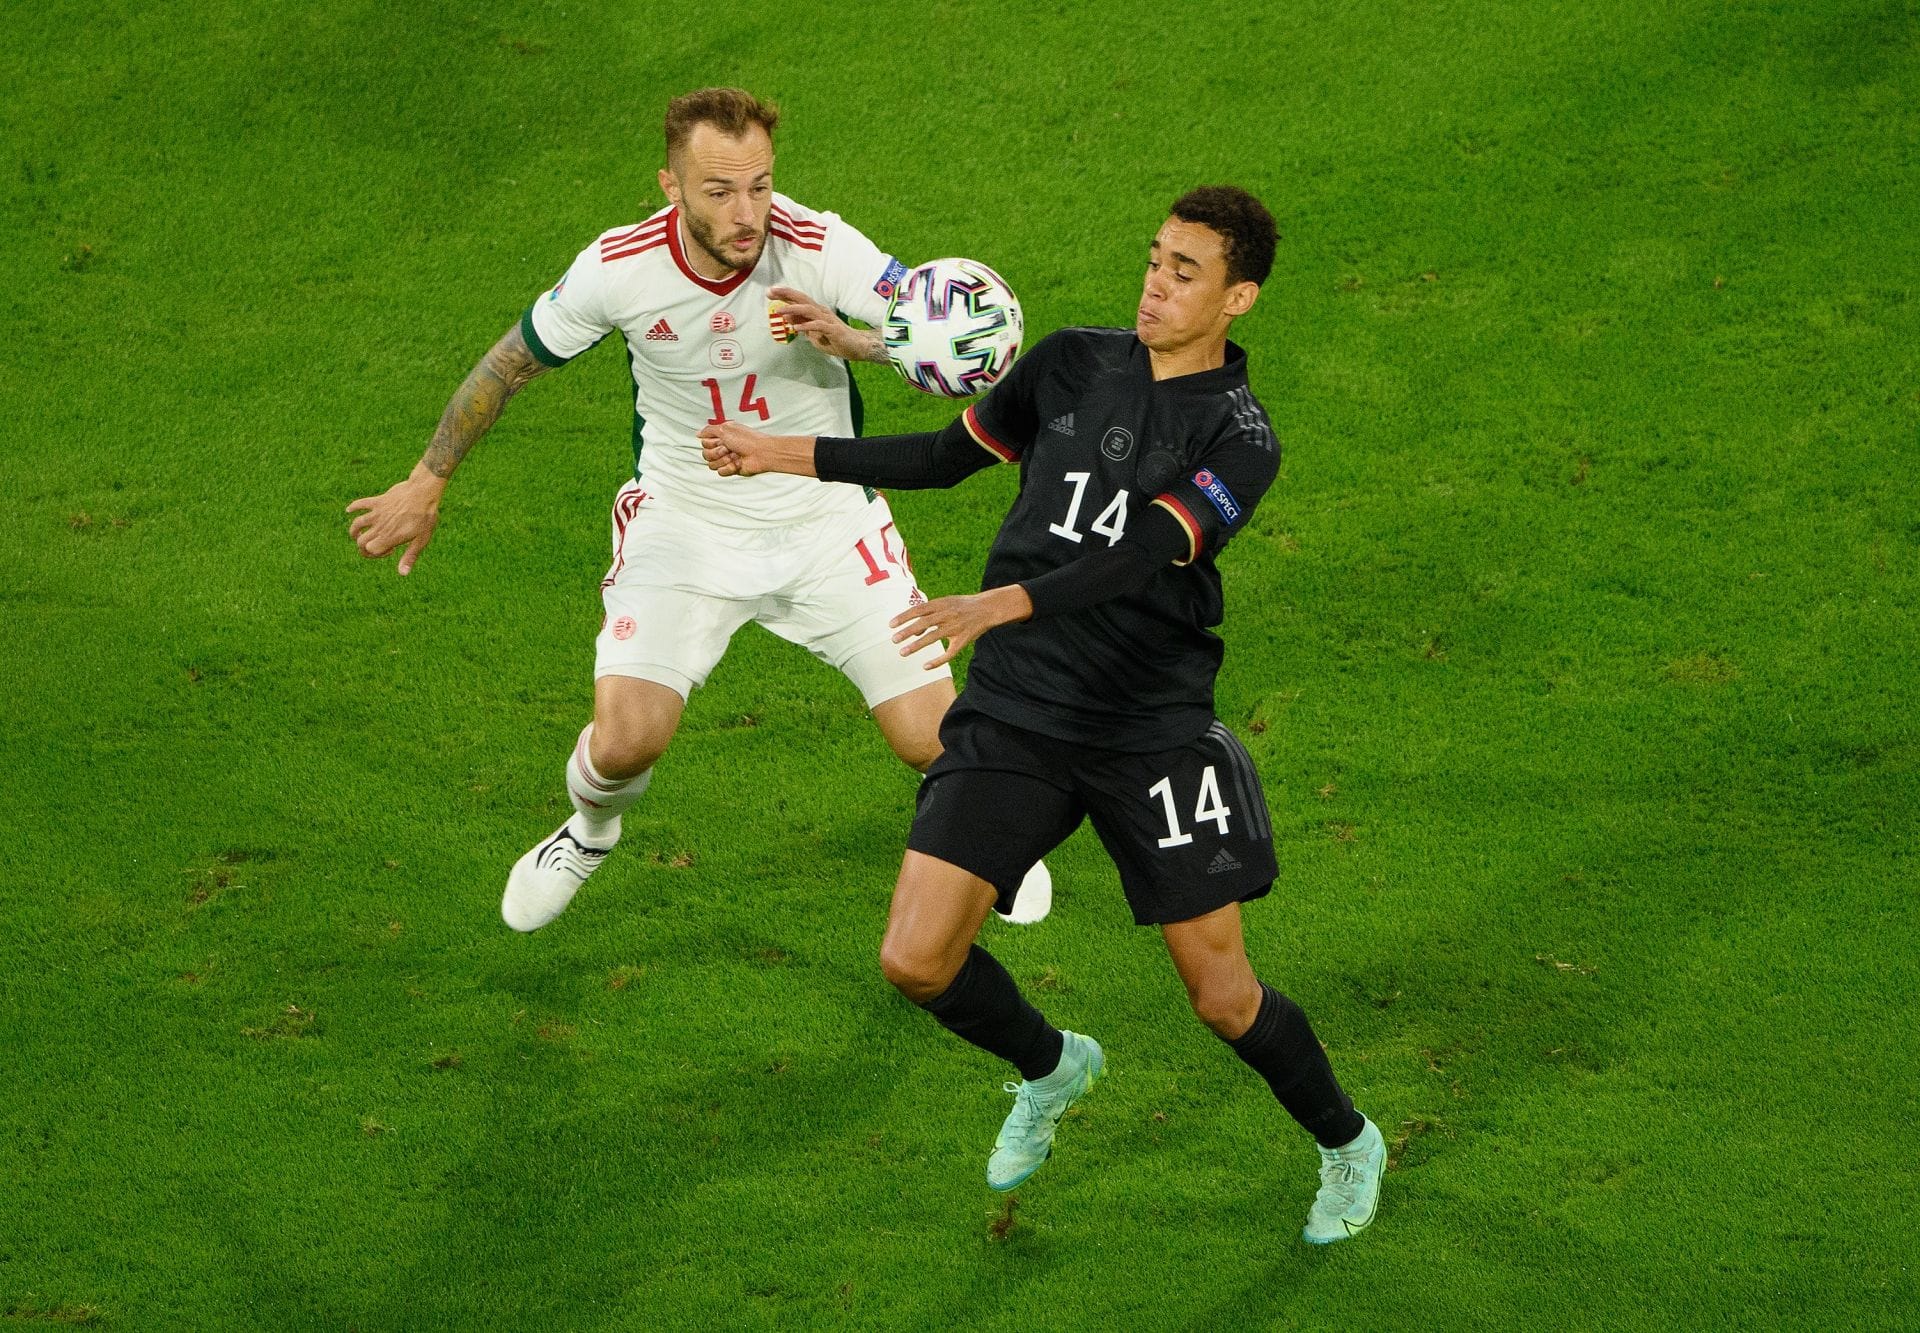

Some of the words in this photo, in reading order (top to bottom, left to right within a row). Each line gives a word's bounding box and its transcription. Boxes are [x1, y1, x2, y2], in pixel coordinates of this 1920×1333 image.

[645, 333, 679, 341] adidas
[702, 373, 771, 425] 14
[1048, 422, 1076, 437] adidas
[1048, 472, 1129, 547] 14
[1208, 483, 1239, 519] RESPECT
[1148, 765, 1232, 849] 14
[1207, 860, 1243, 874] adidas
